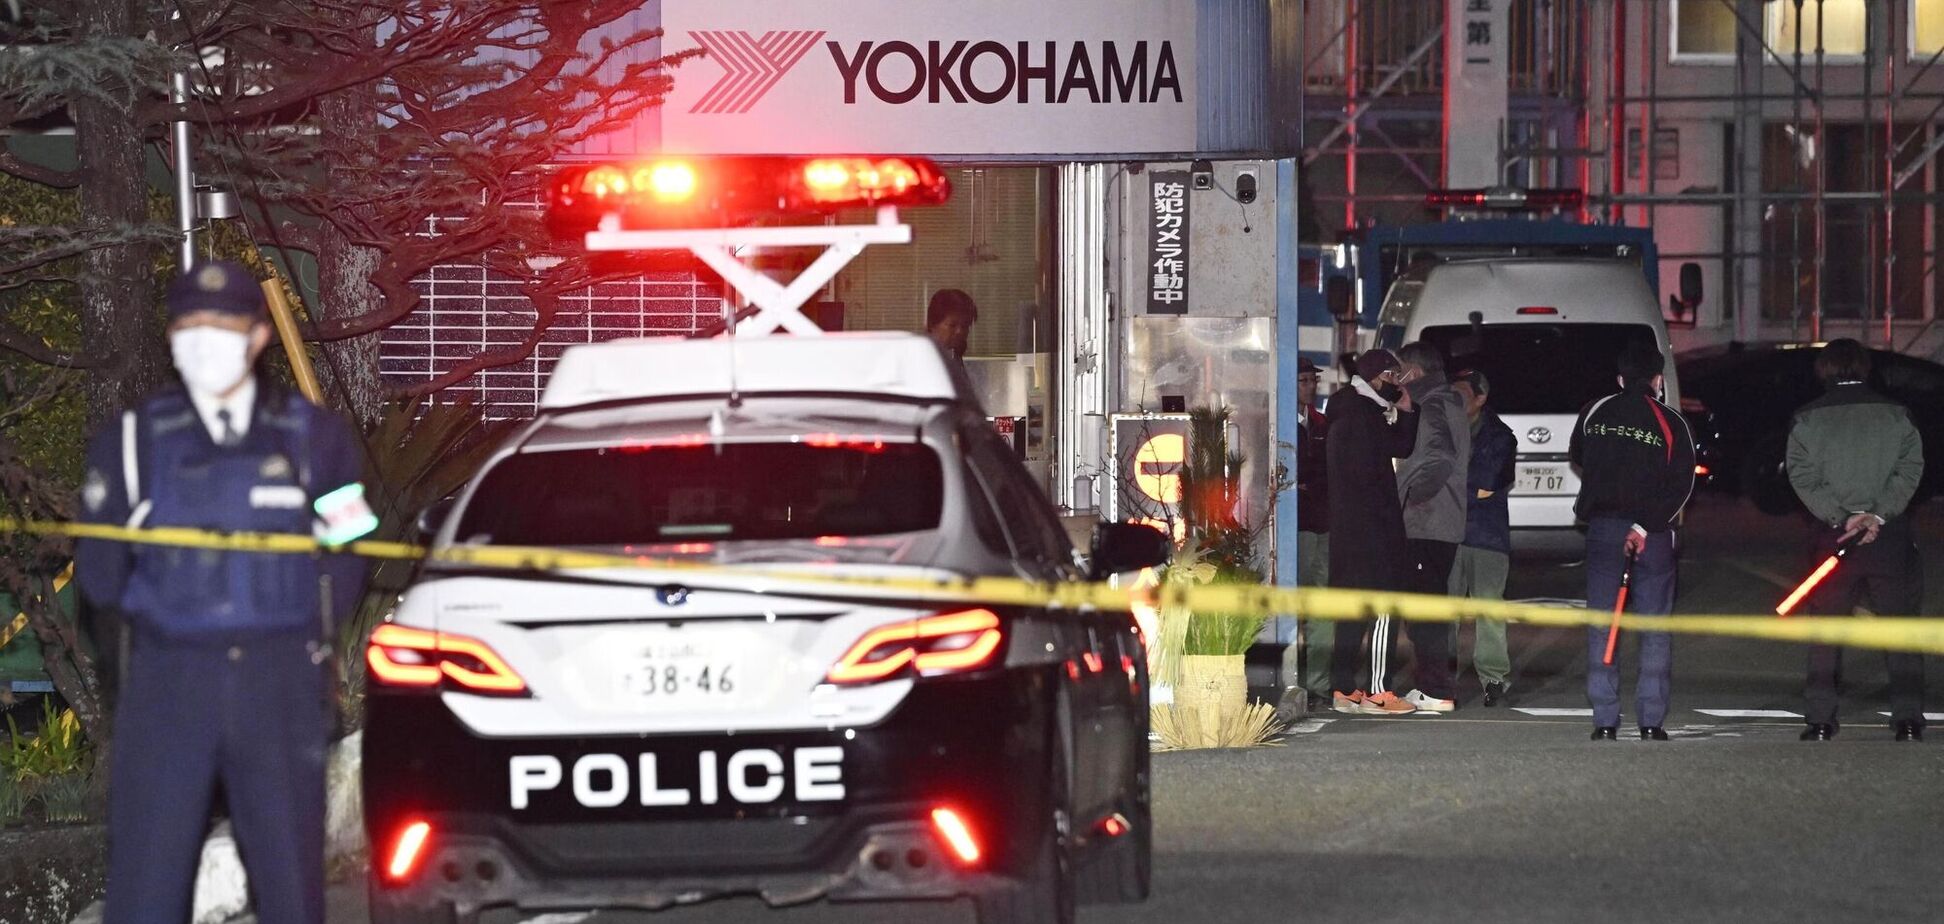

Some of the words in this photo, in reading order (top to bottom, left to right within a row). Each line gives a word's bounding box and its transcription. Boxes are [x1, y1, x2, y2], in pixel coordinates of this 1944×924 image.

[825, 40, 1183, 105] YOKOHAMA
[1153, 182, 1185, 305] 防犯カメラ作動中
[509, 745, 846, 810] POLICE
